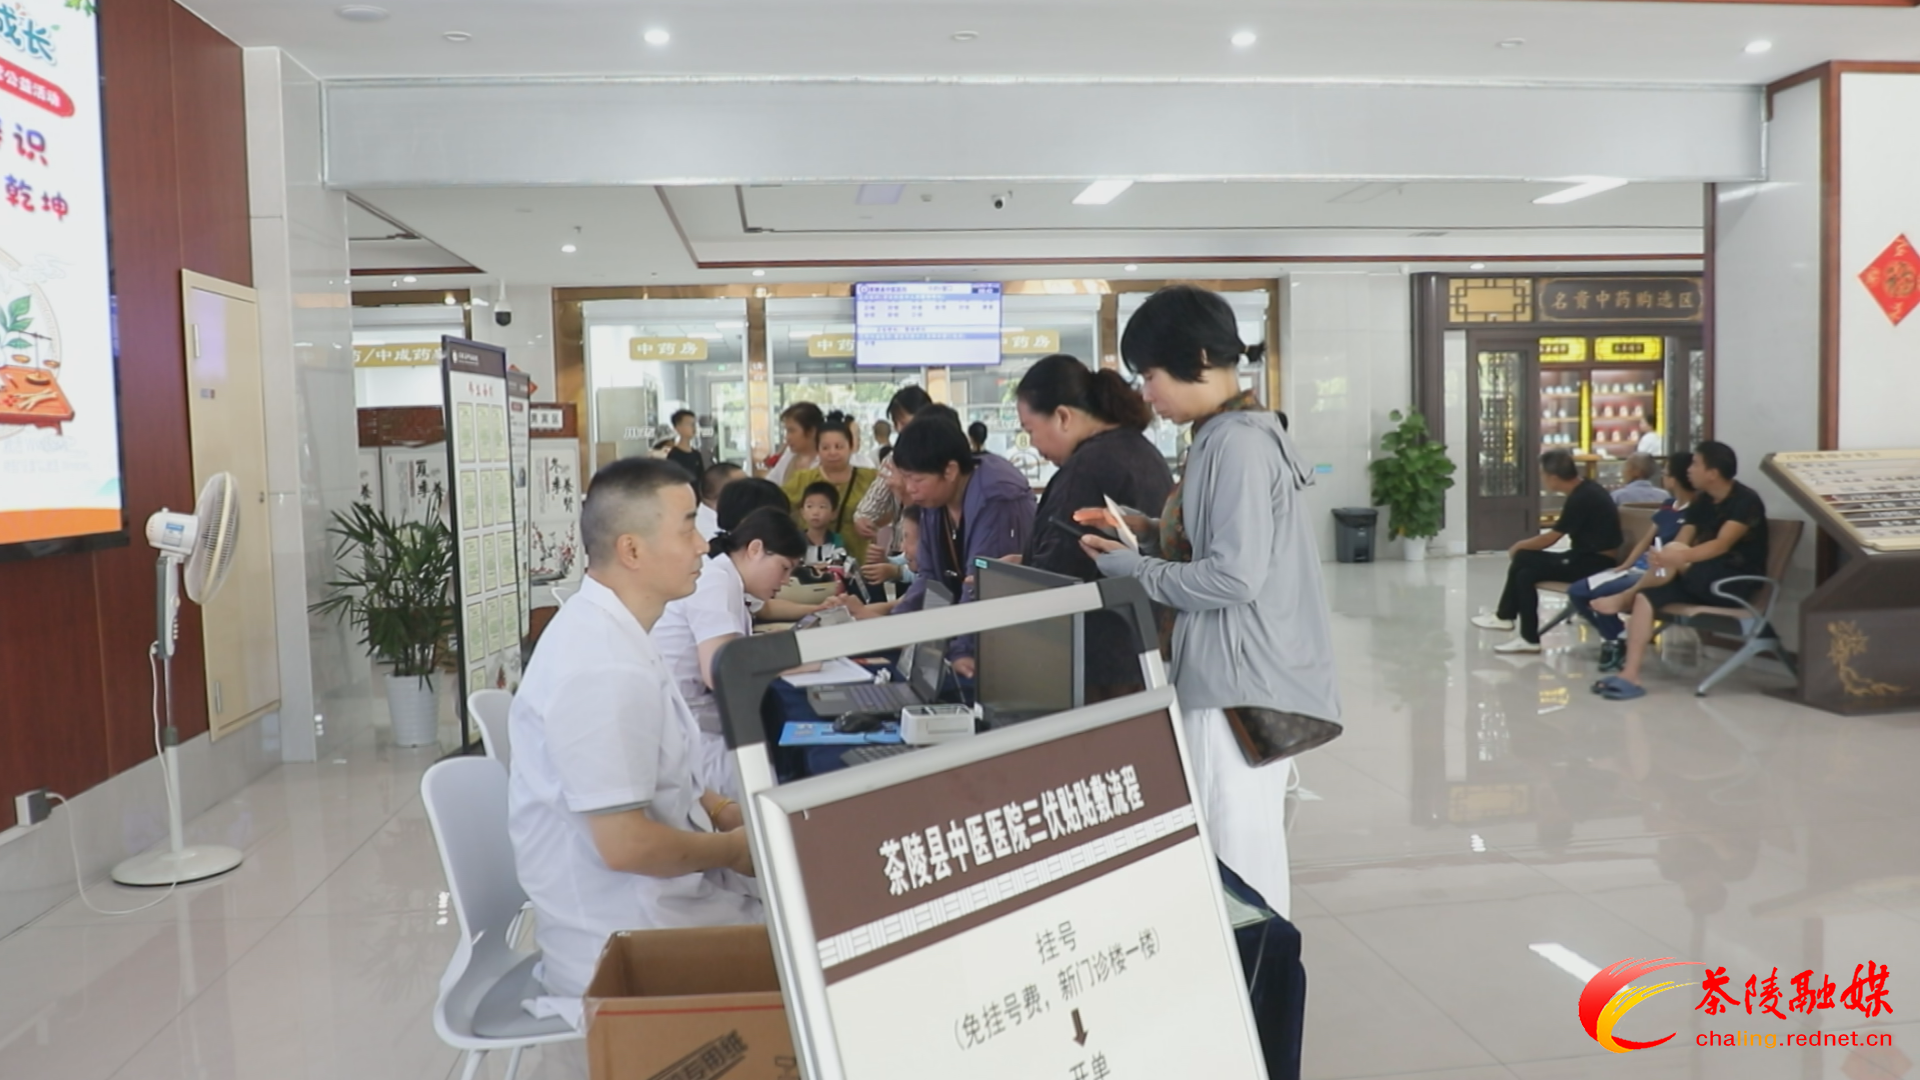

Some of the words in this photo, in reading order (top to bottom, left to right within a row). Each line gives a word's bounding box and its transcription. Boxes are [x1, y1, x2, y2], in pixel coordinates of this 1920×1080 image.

[0, 65, 61, 108] 公益活动
[4, 174, 69, 221] 乾坤
[636, 342, 698, 355] 中药房
[879, 764, 1145, 896] 茶陵县中医医院三伏贴贴敷流程
[1035, 920, 1077, 964] 挂号
